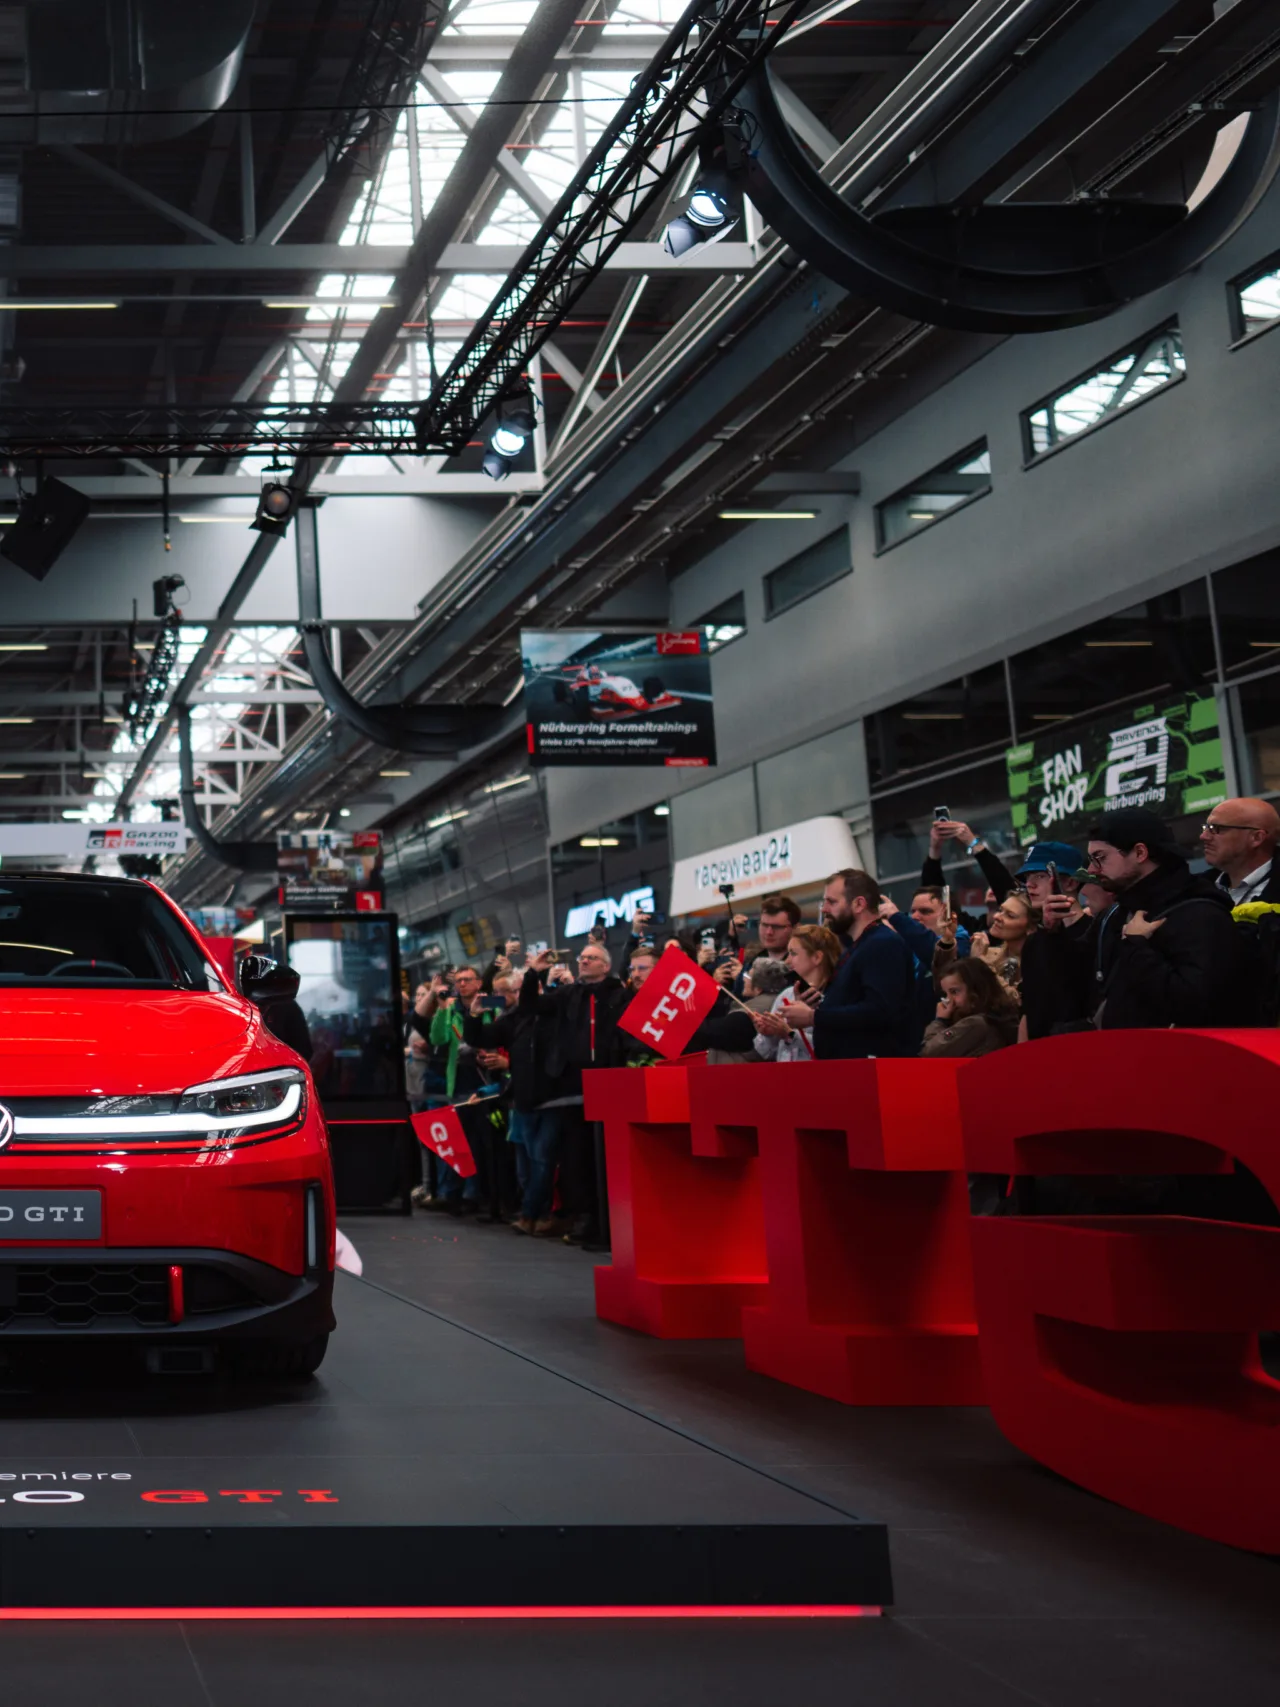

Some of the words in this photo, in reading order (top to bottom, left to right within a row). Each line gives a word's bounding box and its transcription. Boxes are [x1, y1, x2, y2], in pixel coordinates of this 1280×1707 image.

[539, 722, 606, 735] Nürburgring
[608, 721, 698, 734] Formeltrainings
[1115, 723, 1161, 744] RAVENOL
[1042, 743, 1083, 793] FAN
[1039, 776, 1089, 828] SHOP
[1104, 786, 1166, 812] nürburgring
[124, 839, 176, 849] Racing
[694, 833, 792, 889] racewear24
[24, 1206, 85, 1222] GTI
[140, 1489, 339, 1503] GTI
